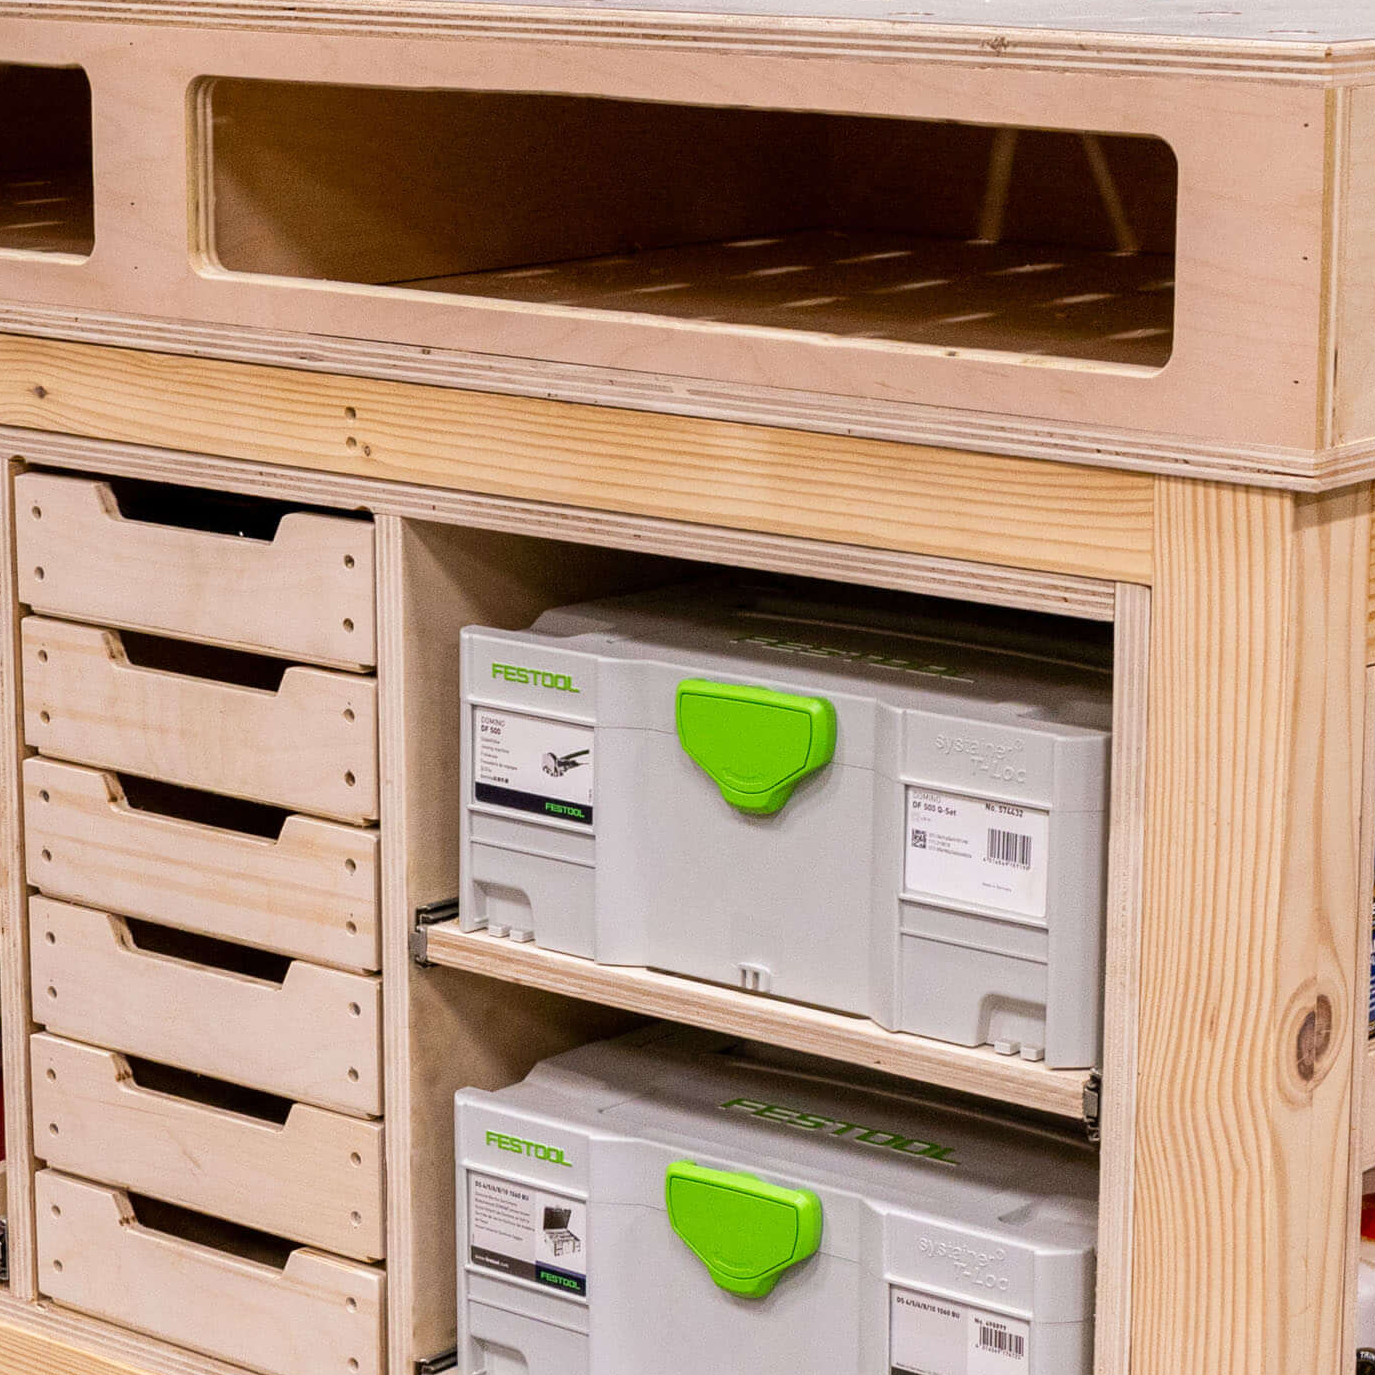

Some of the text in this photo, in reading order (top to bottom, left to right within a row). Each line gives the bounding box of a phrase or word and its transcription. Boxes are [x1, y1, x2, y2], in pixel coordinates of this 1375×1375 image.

[491, 662, 581, 694] FESTOOL
[545, 801, 586, 819] FESTOOL
[912, 800, 922, 808] DF
[923, 802, 937, 813] 500
[719, 1097, 962, 1167] FESTOOL
[485, 1130, 573, 1167] FESTOOL
[539, 1270, 581, 1291] FESTOOL
[896, 1295, 905, 1305] DS
